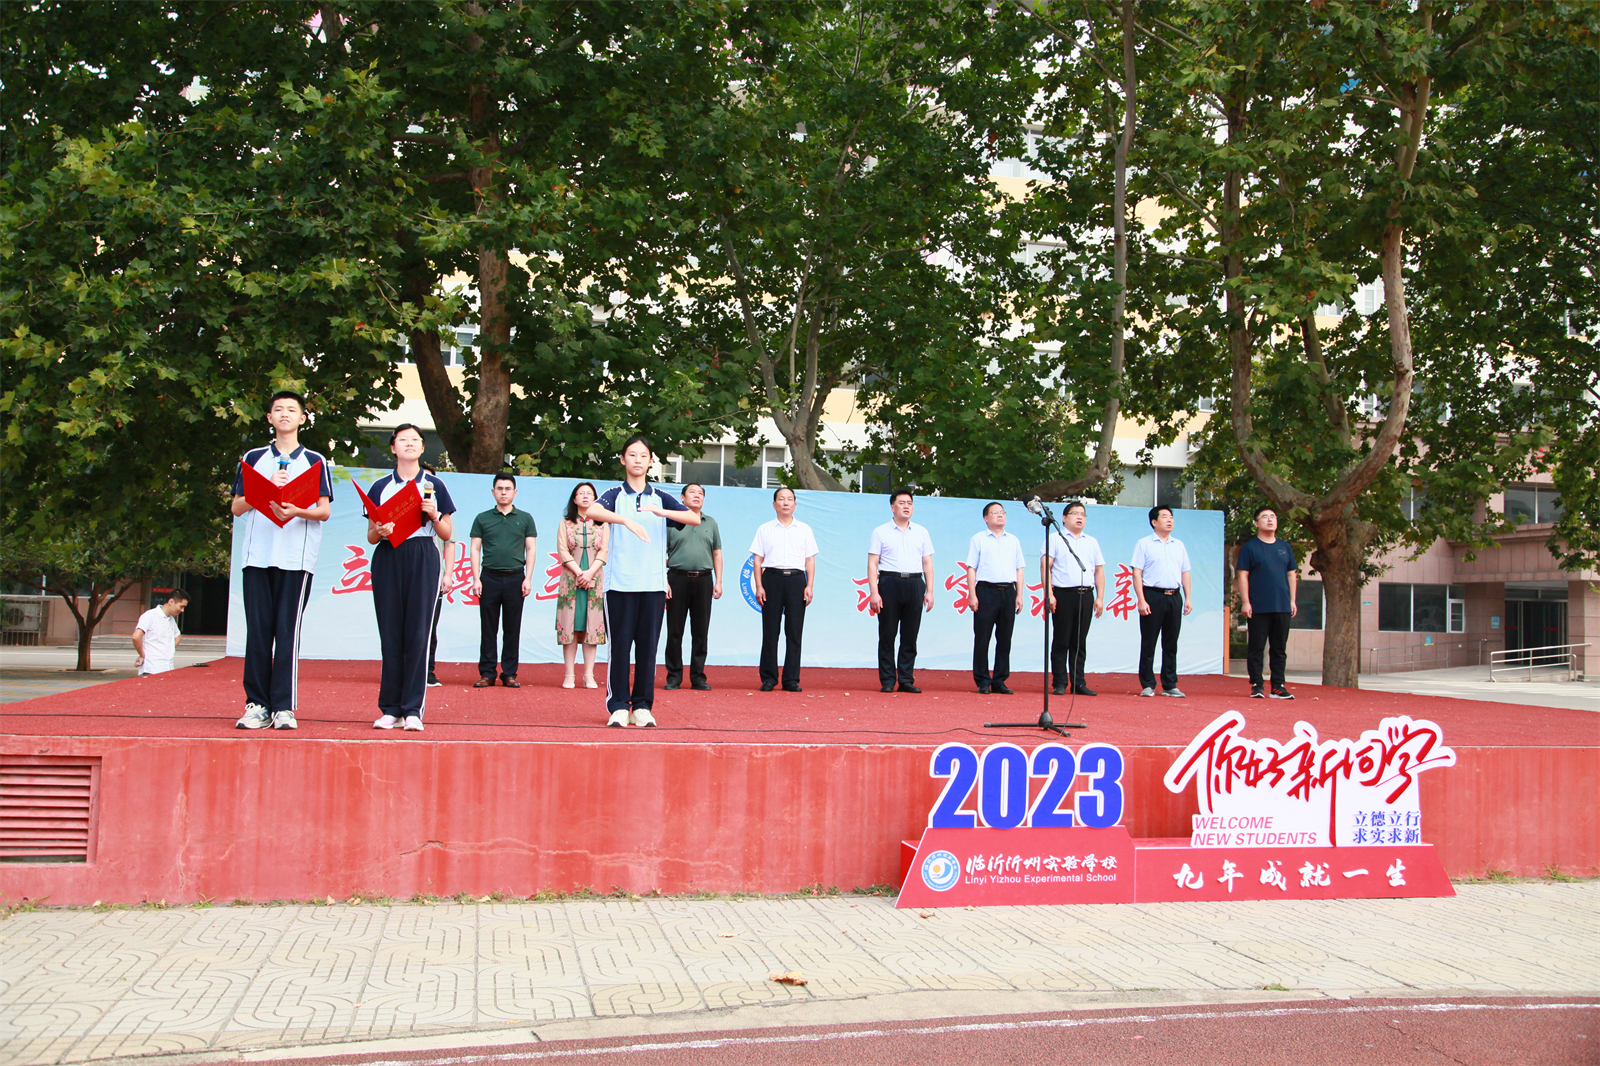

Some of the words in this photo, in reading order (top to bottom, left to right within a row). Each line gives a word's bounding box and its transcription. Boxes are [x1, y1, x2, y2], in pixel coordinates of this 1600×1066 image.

[931, 744, 1123, 829] 2023
[1194, 816, 1274, 830] WELCOME
[1353, 810, 1420, 827] 立德立行
[1194, 832, 1232, 846] NEW
[1235, 832, 1317, 845] STUDENTS
[1353, 827, 1420, 844] 求实求新
[965, 854, 1118, 875] 临沂沂州实验学校
[965, 874, 987, 884] Linyi
[990, 874, 1021, 883] Yizhou
[1024, 873, 1084, 884] Experimental
[1086, 873, 1117, 882] School
[1173, 859, 1407, 893] 九年成就一生
